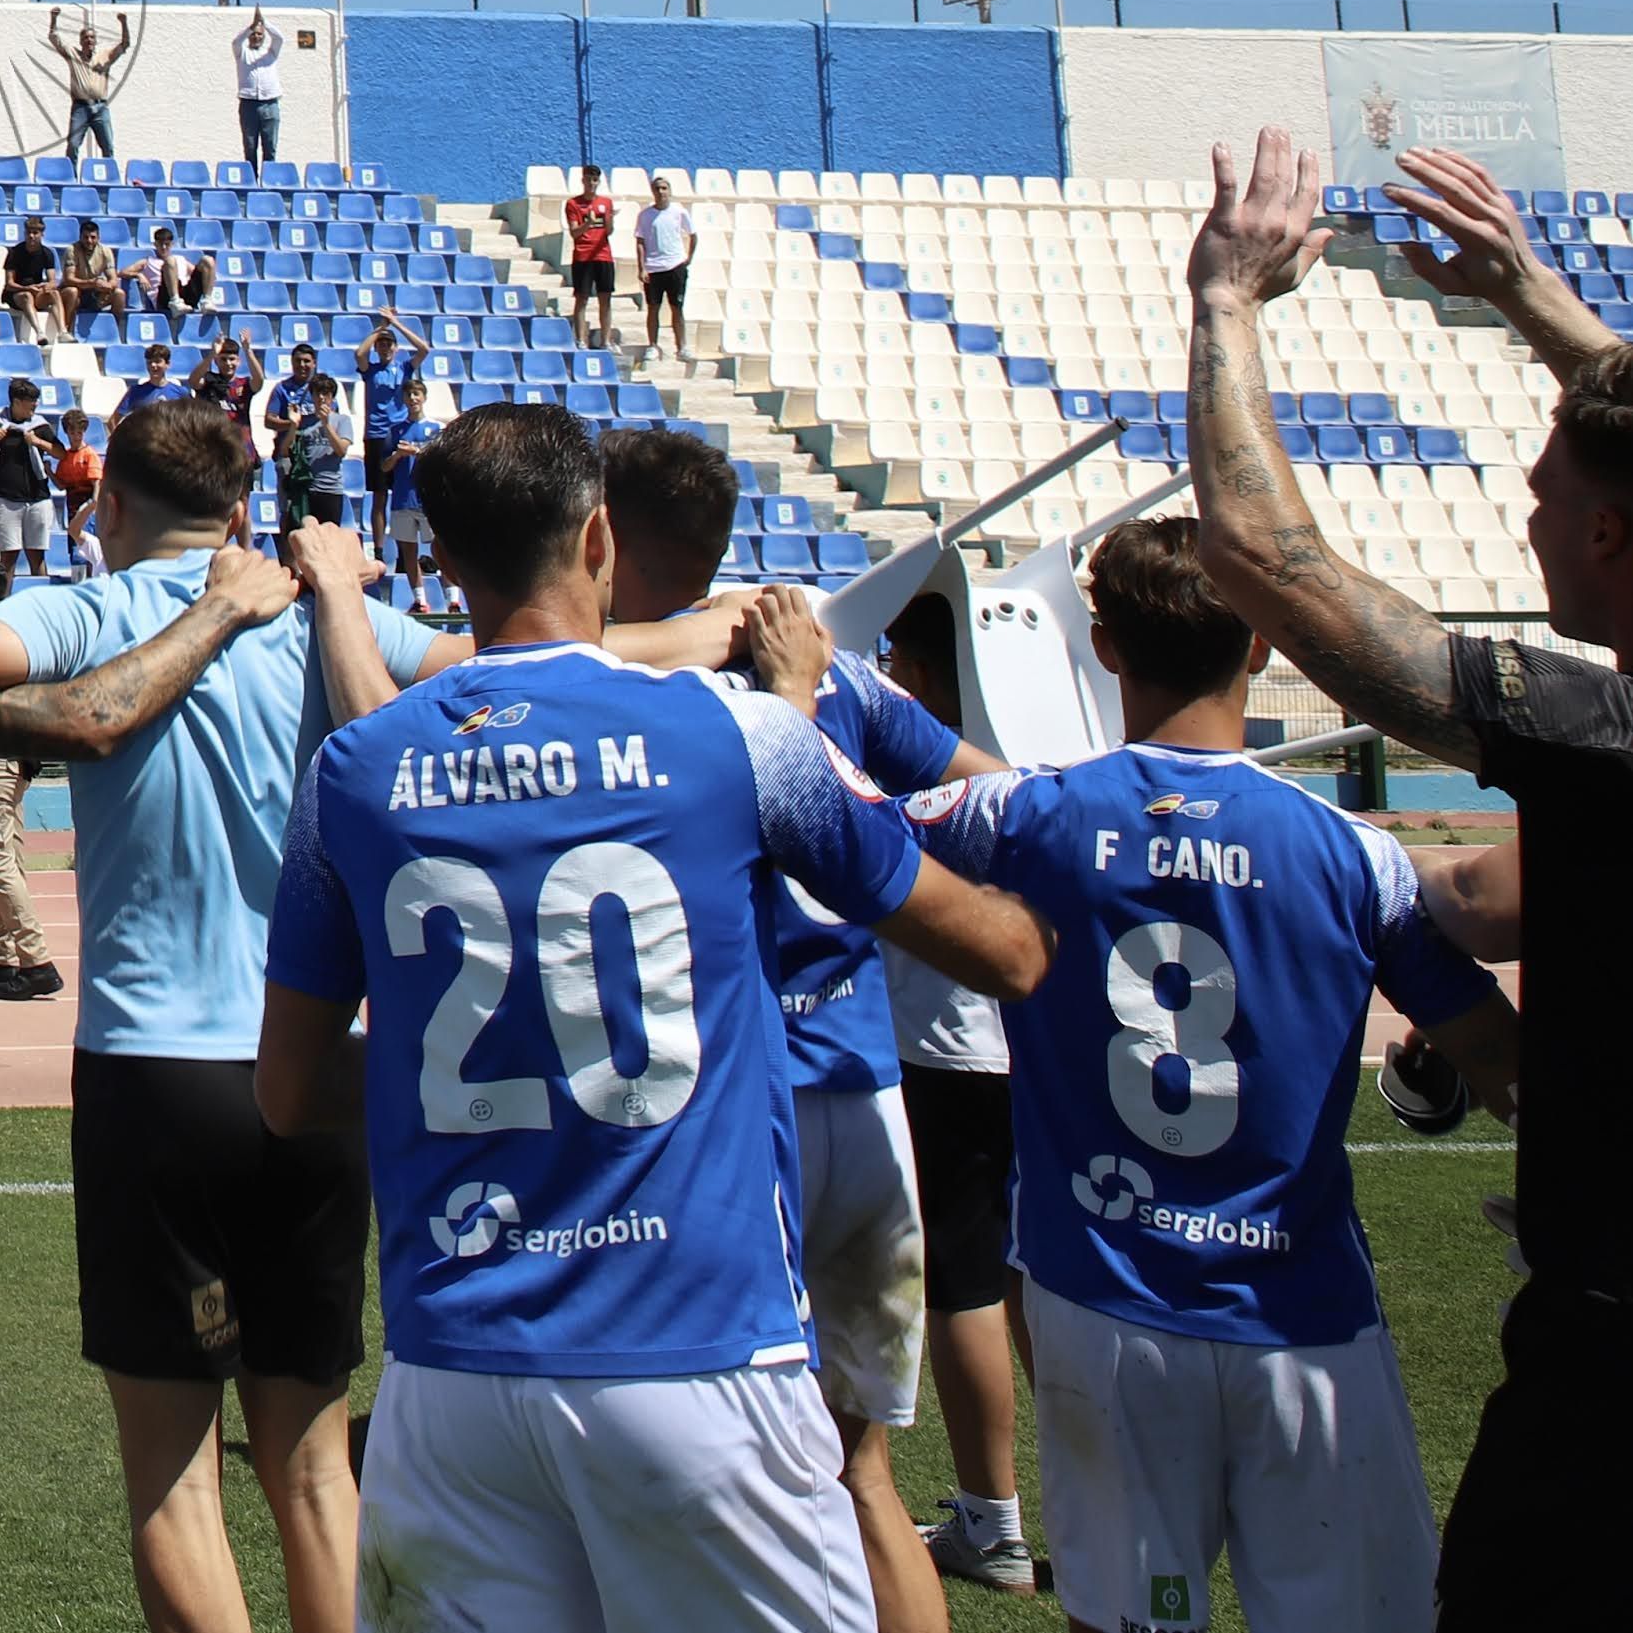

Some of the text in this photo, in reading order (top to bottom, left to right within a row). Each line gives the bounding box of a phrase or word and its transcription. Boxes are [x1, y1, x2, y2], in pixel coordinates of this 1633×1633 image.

[1415, 115, 1537, 141] MELILLA
[388, 734, 670, 811] ÁLVARO M.
[1094, 829, 1264, 889] F CANO.
[383, 841, 702, 1134] 20
[1106, 920, 1240, 1157] 8
[505, 1209, 669, 1260] serglobin
[1137, 1203, 1291, 1252] serglobin
